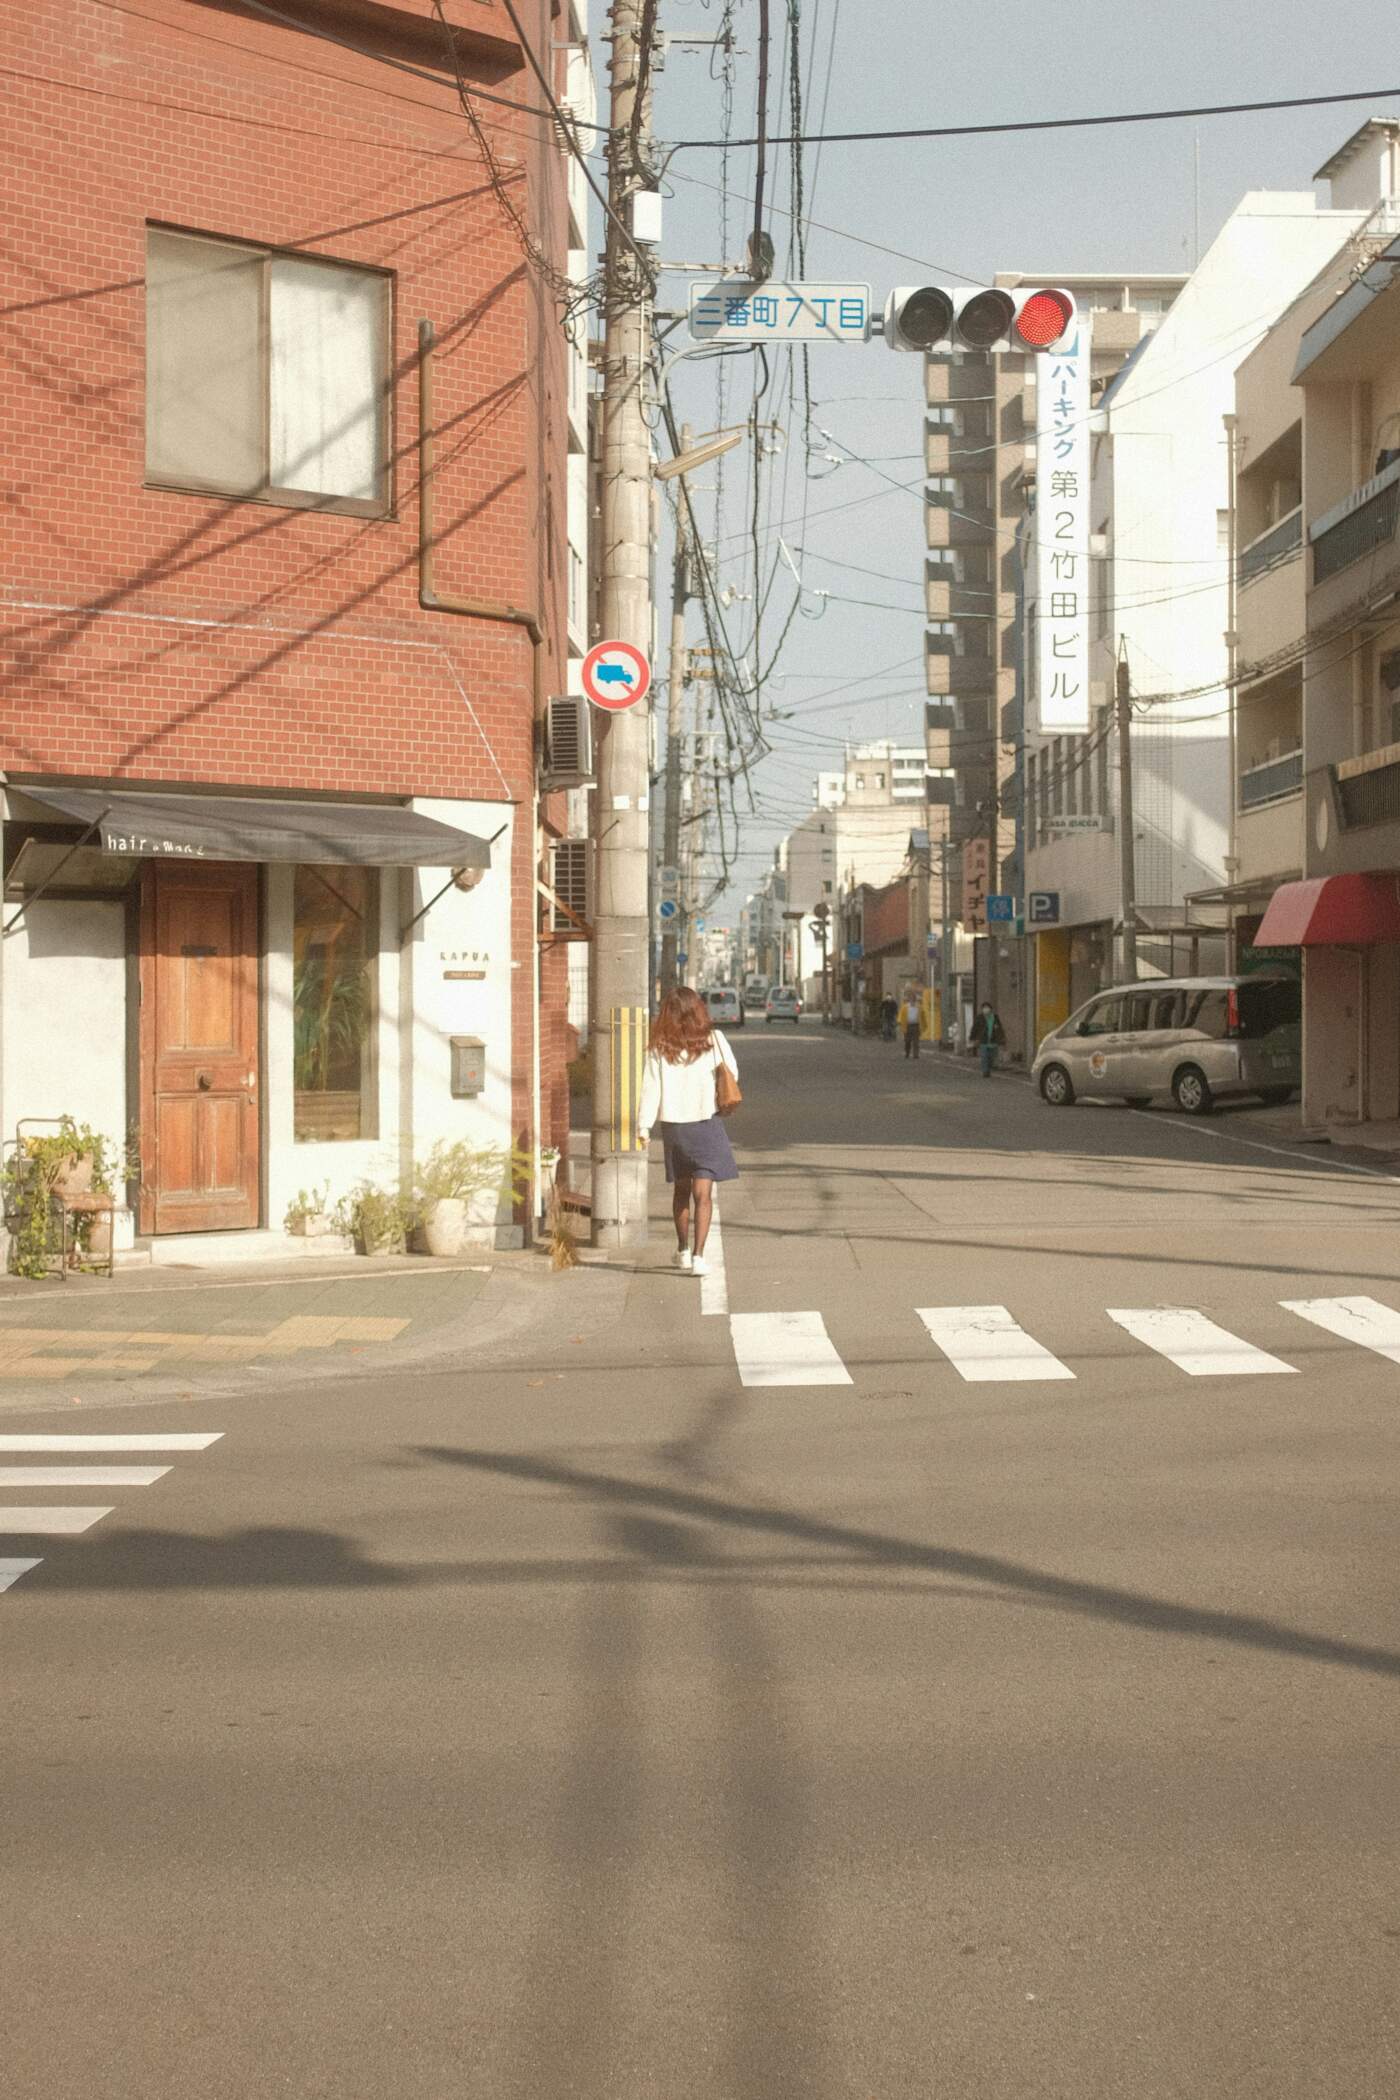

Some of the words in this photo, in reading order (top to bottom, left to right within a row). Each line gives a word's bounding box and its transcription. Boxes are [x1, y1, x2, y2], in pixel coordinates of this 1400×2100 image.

[696, 296, 864, 328] 三番町7丁目
[1051, 360, 1078, 460] パーキング
[1049, 469, 1080, 700] 第2竹田ビル
[107, 834, 148, 851] hair
[1031, 895, 1051, 920] P
